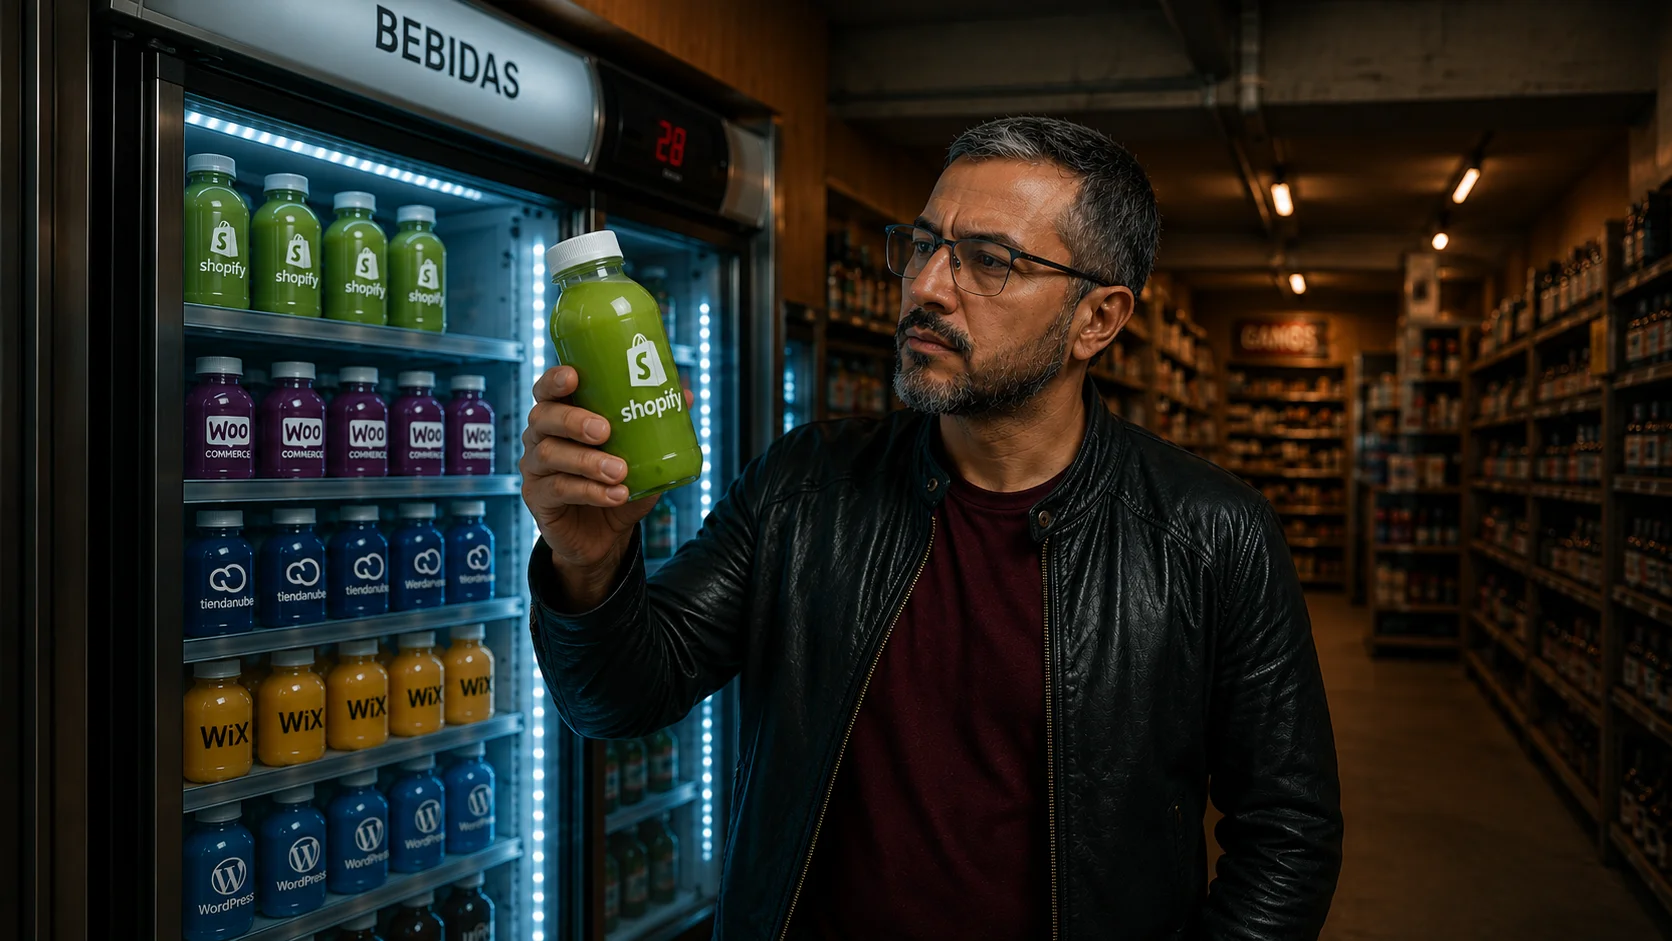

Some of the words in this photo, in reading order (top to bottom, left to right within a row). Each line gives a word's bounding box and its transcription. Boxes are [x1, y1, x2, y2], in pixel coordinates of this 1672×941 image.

[375, 4, 520, 99] BEBIDAS
[656, 119, 687, 167] 28
[199, 258, 246, 279] shopify
[275, 269, 319, 289] shopify
[345, 280, 386, 300] shopify
[620, 387, 682, 423] shopify
[205, 449, 251, 459] COMMERCE
[200, 596, 254, 609] tiendanube
[276, 589, 327, 602] tiendanube
[276, 870, 327, 891] WordPress
[199, 892, 254, 915] WordPress
